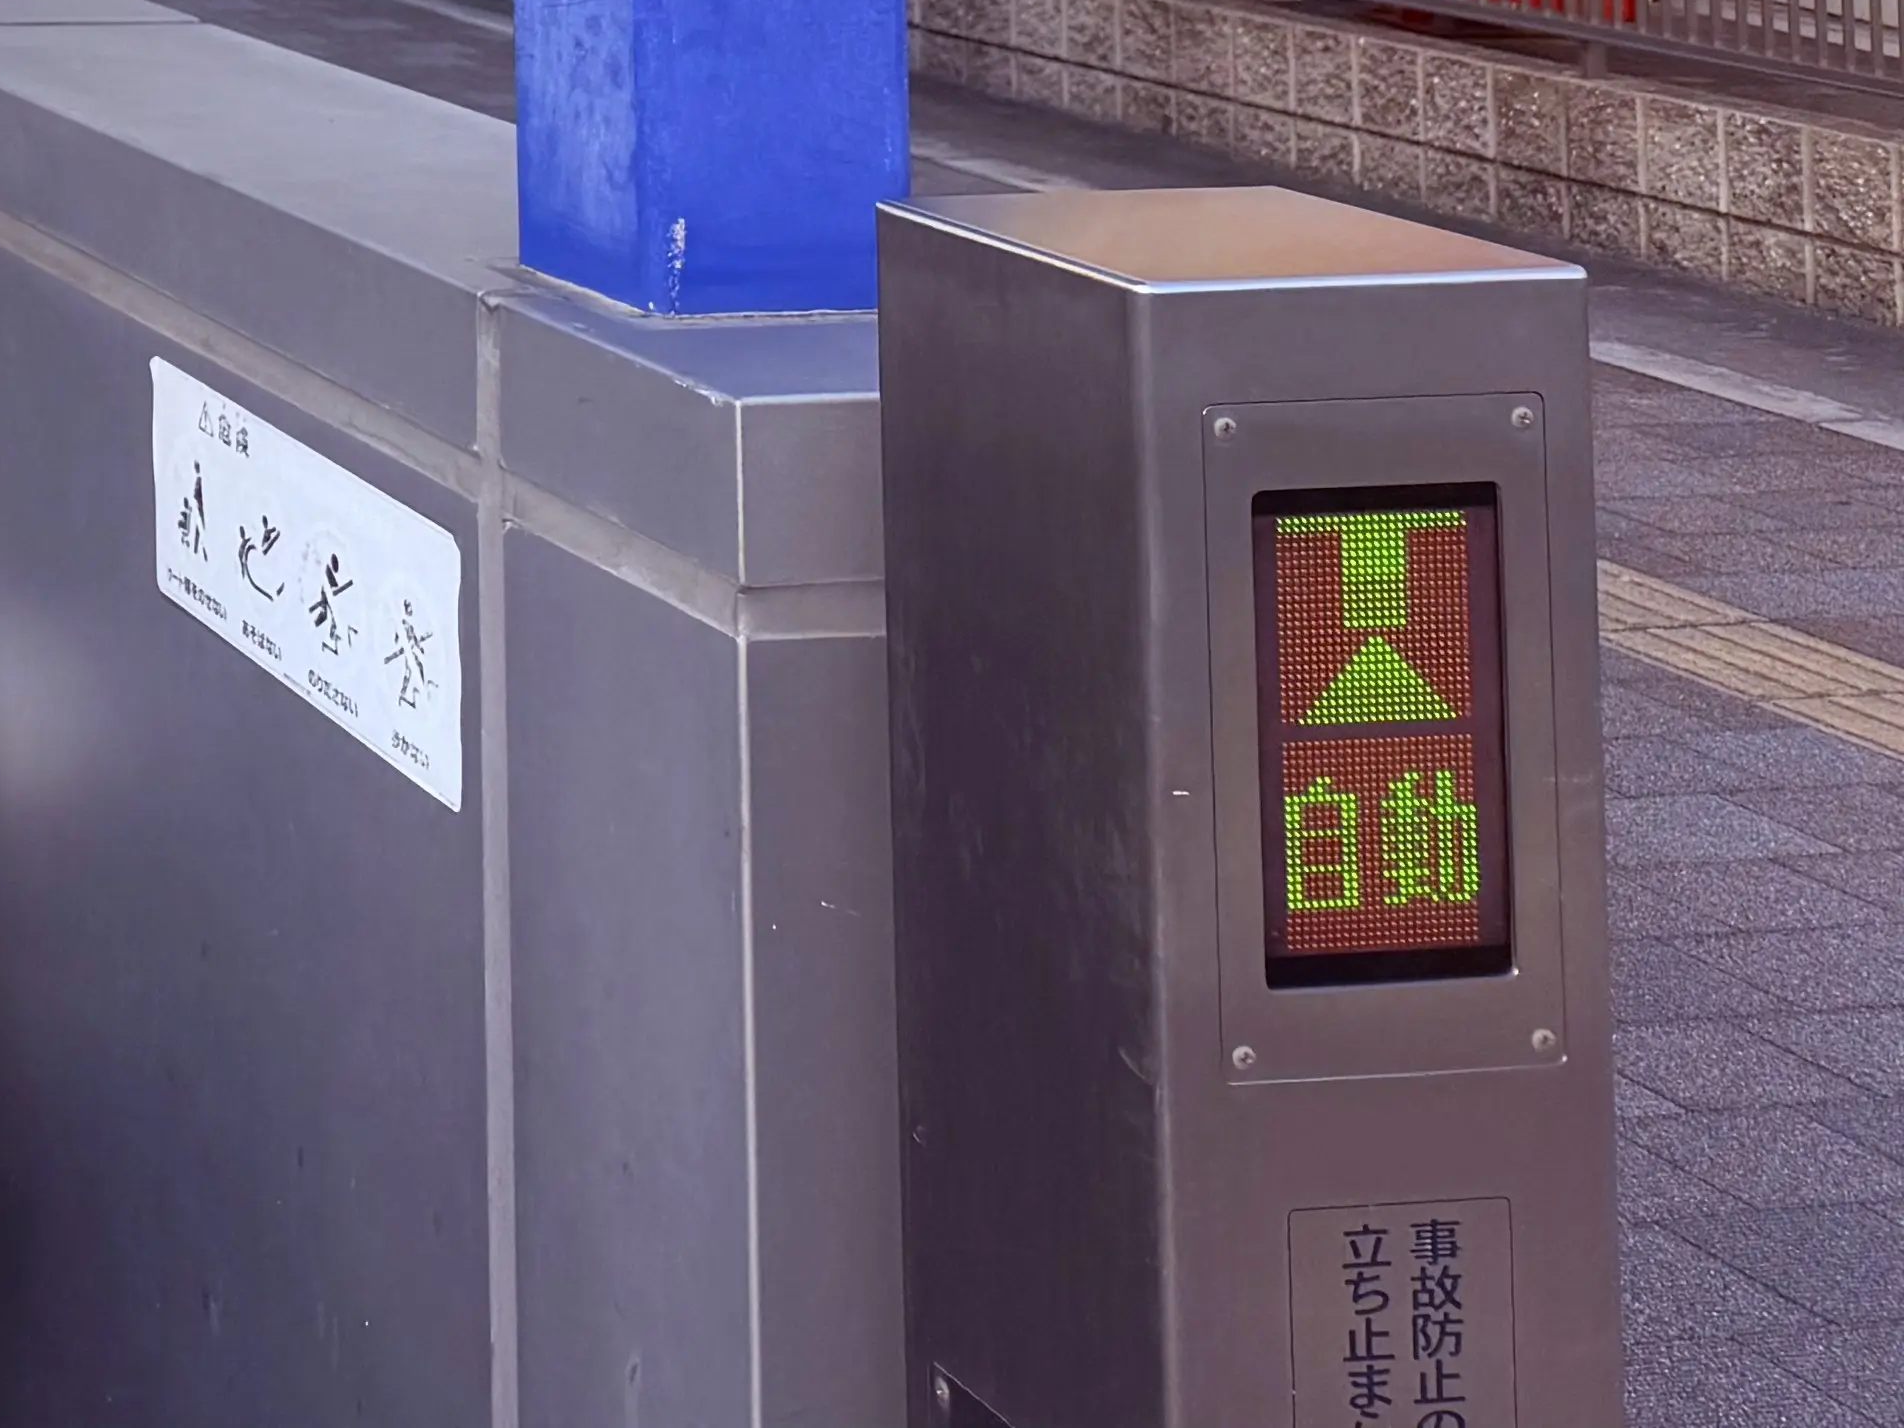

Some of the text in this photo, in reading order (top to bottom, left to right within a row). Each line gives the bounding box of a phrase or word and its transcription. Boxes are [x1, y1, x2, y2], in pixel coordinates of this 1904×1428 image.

[1282, 769, 1481, 912] 自動
[1341, 1223, 1396, 1428] 立ち止ま
